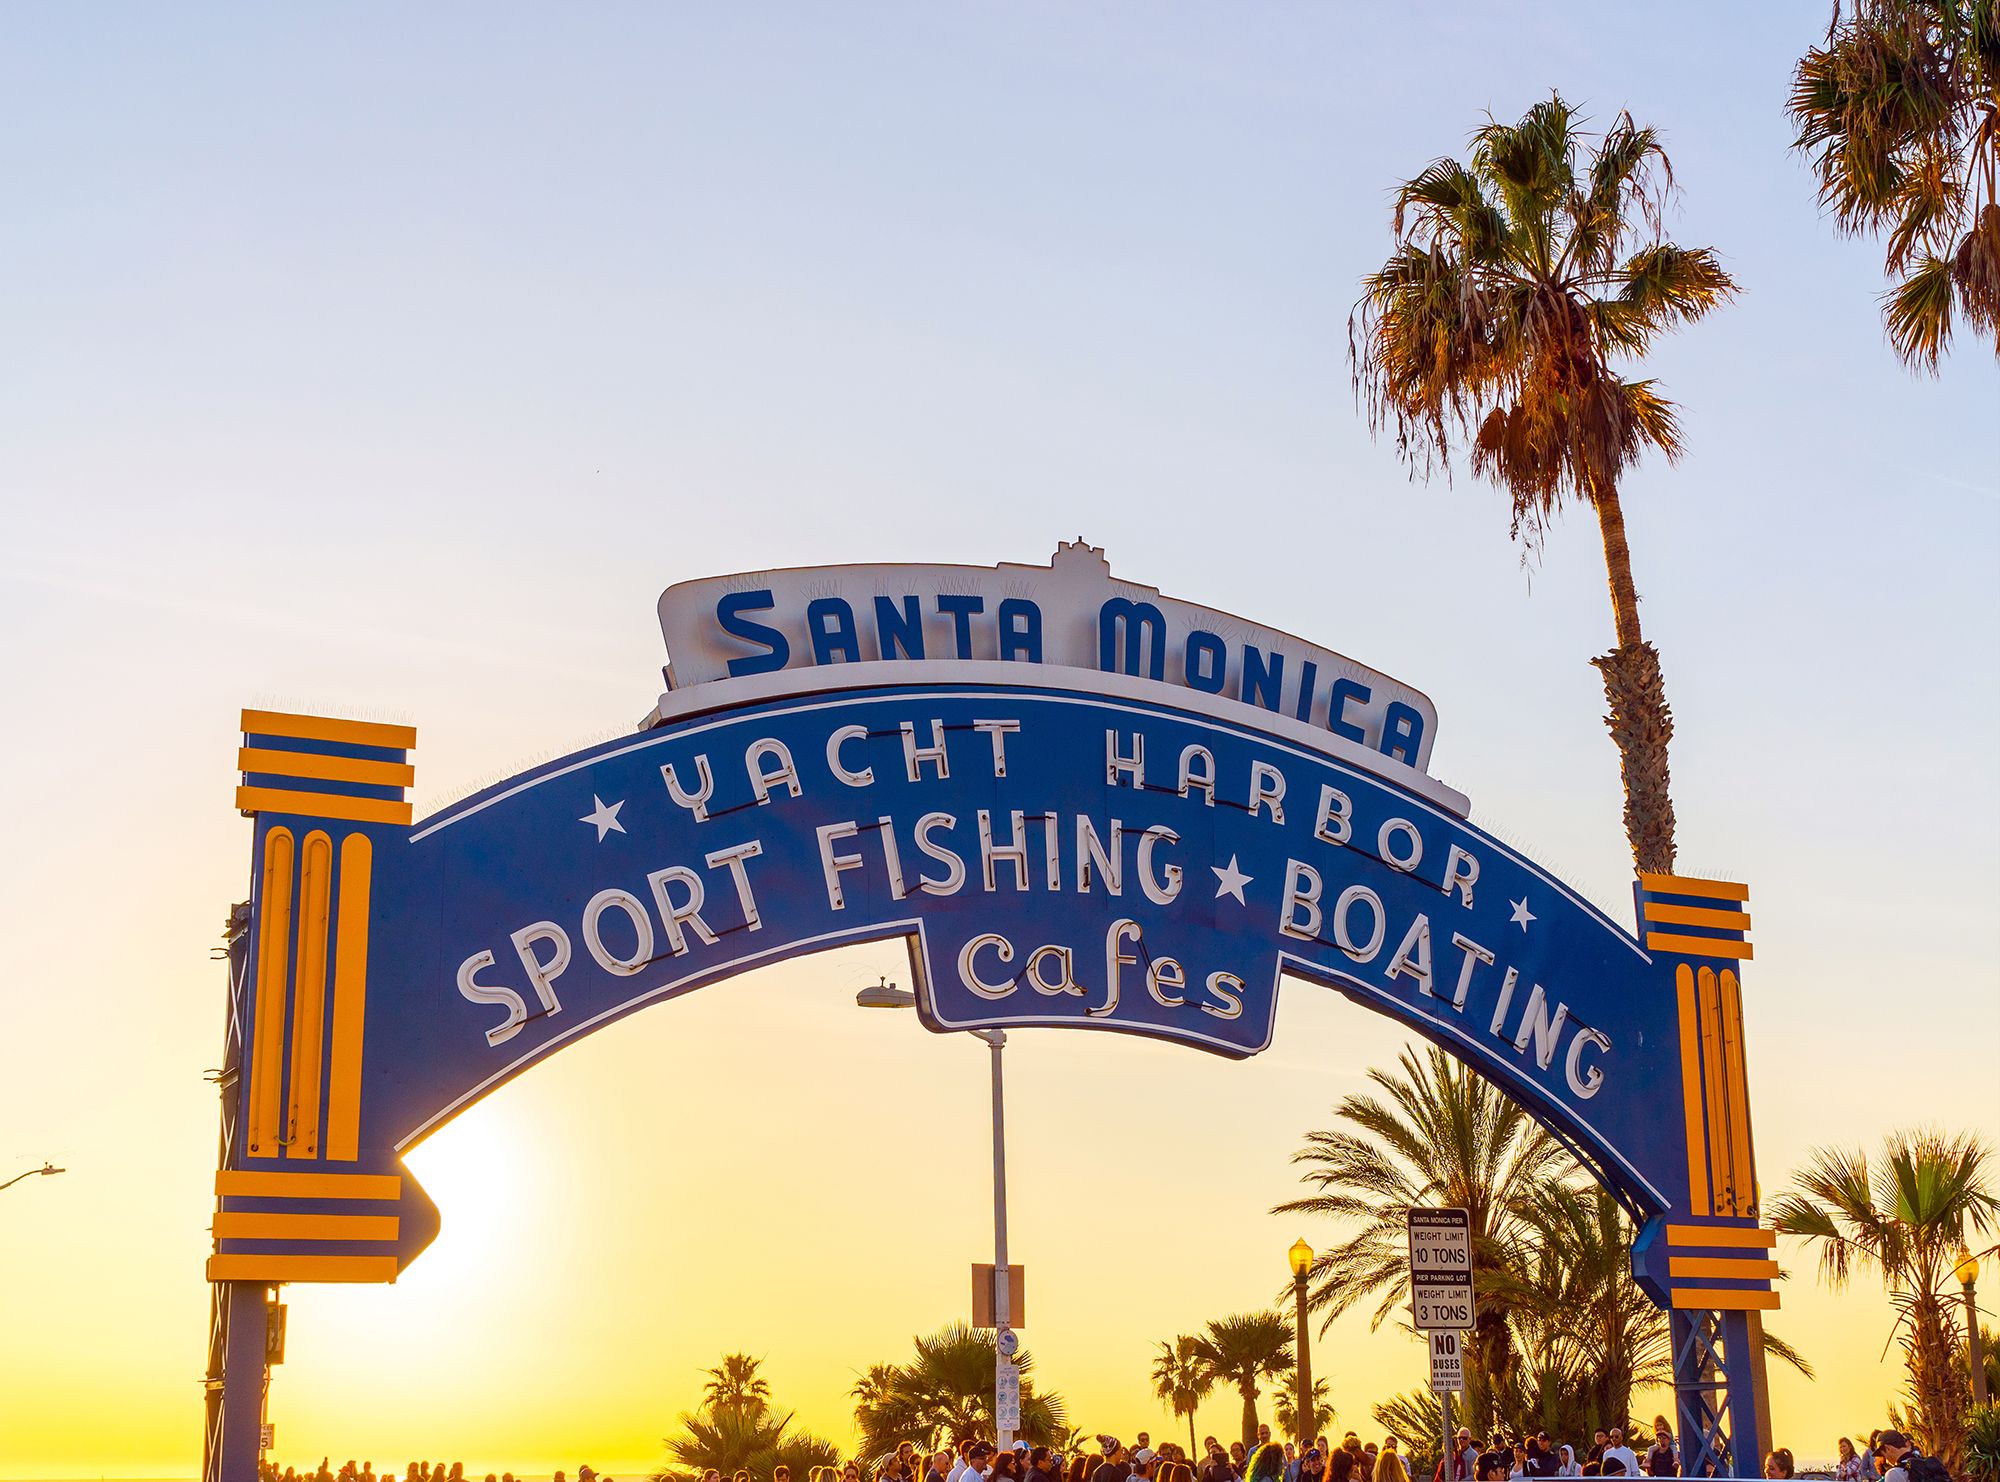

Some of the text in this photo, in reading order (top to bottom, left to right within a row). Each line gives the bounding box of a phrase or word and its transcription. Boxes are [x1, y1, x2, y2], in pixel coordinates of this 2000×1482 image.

[717, 589, 1425, 769] SANTA MONICA
[660, 719, 1480, 910] YACHT HARBOR
[456, 809, 1612, 1099] SPORT FISHING BOATING
[1413, 1216, 1430, 1224] SANTA
[1414, 1232, 1464, 1241] WEIGHT LIMIT
[1415, 1248, 1466, 1264] 10 TONS
[1417, 1290, 1467, 1299] WEIGHT LIMIT
[1420, 1305, 1468, 1320] 3 TONS
[1435, 1335, 1455, 1355] NO
[1433, 1359, 1460, 1370] BUSES
